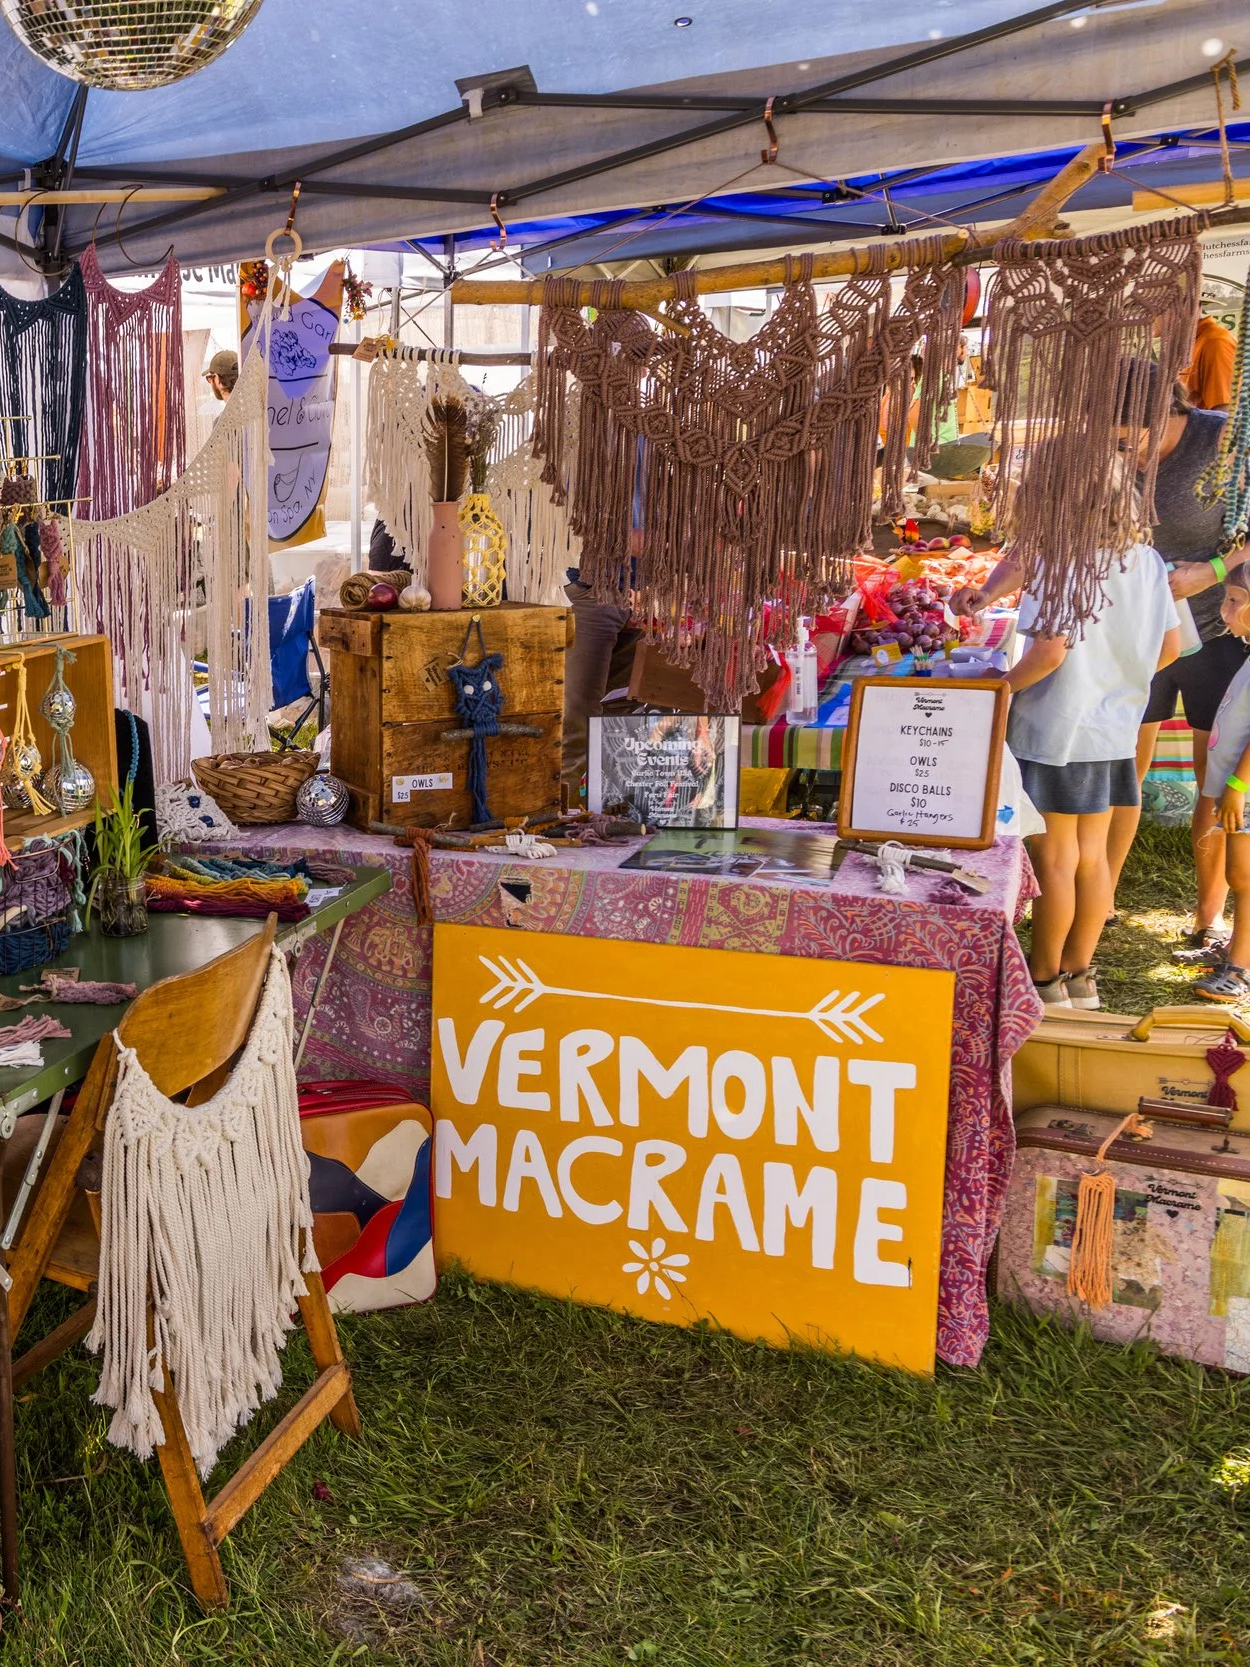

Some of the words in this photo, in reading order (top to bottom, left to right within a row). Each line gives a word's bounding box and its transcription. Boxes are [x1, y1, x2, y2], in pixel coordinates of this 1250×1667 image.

[901, 725, 953, 737] KEYCHAINS
[624, 737, 702, 754] Upcoming
[636, 753, 689, 766] Events
[910, 756, 937, 767] OWLS
[915, 768, 930, 777] $25
[412, 779, 433, 788] OWLS
[890, 783, 919, 794] DISCO
[922, 785, 951, 796] BALLS
[397, 791, 408, 799] $25
[910, 797, 927, 808] $10
[887, 809, 913, 818] Garlic
[916, 810, 954, 824] Hangers
[438, 1017, 916, 1163] VERMONT
[1161, 1086, 1209, 1098] Vermont
[1148, 1183, 1197, 1199] Vermont
[435, 1119, 912, 1287] MACRAME
[1146, 1194, 1202, 1211] Macrame
